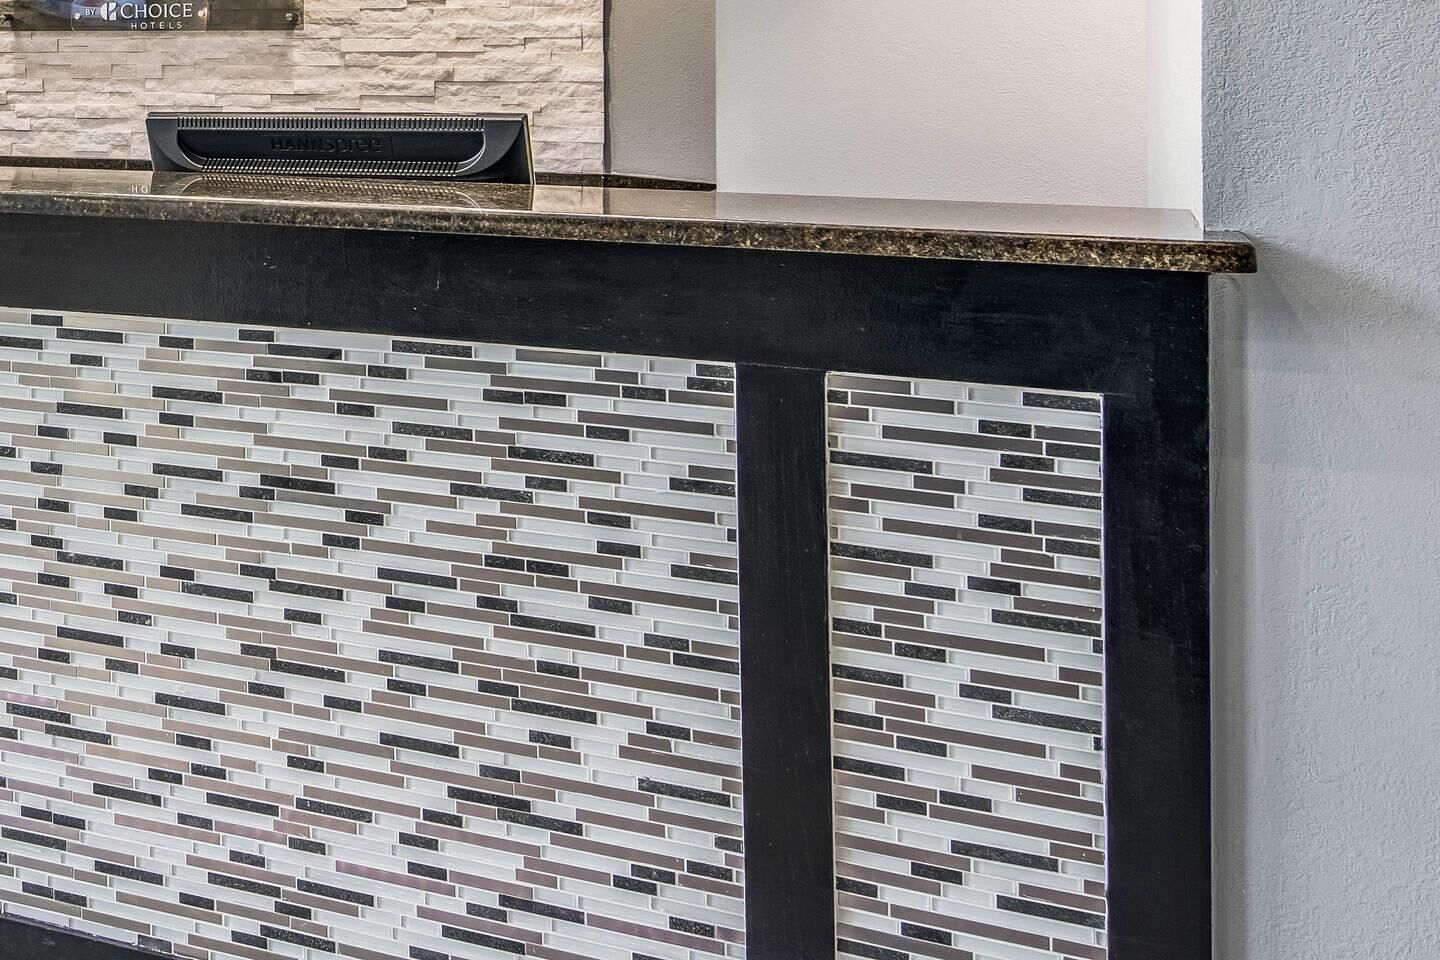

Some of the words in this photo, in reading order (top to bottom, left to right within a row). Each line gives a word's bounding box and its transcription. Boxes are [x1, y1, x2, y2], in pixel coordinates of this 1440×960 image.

[85, 8, 97, 16] BY
[120, 2, 193, 19] CHOICE
[130, 21, 183, 30] HOTELS
